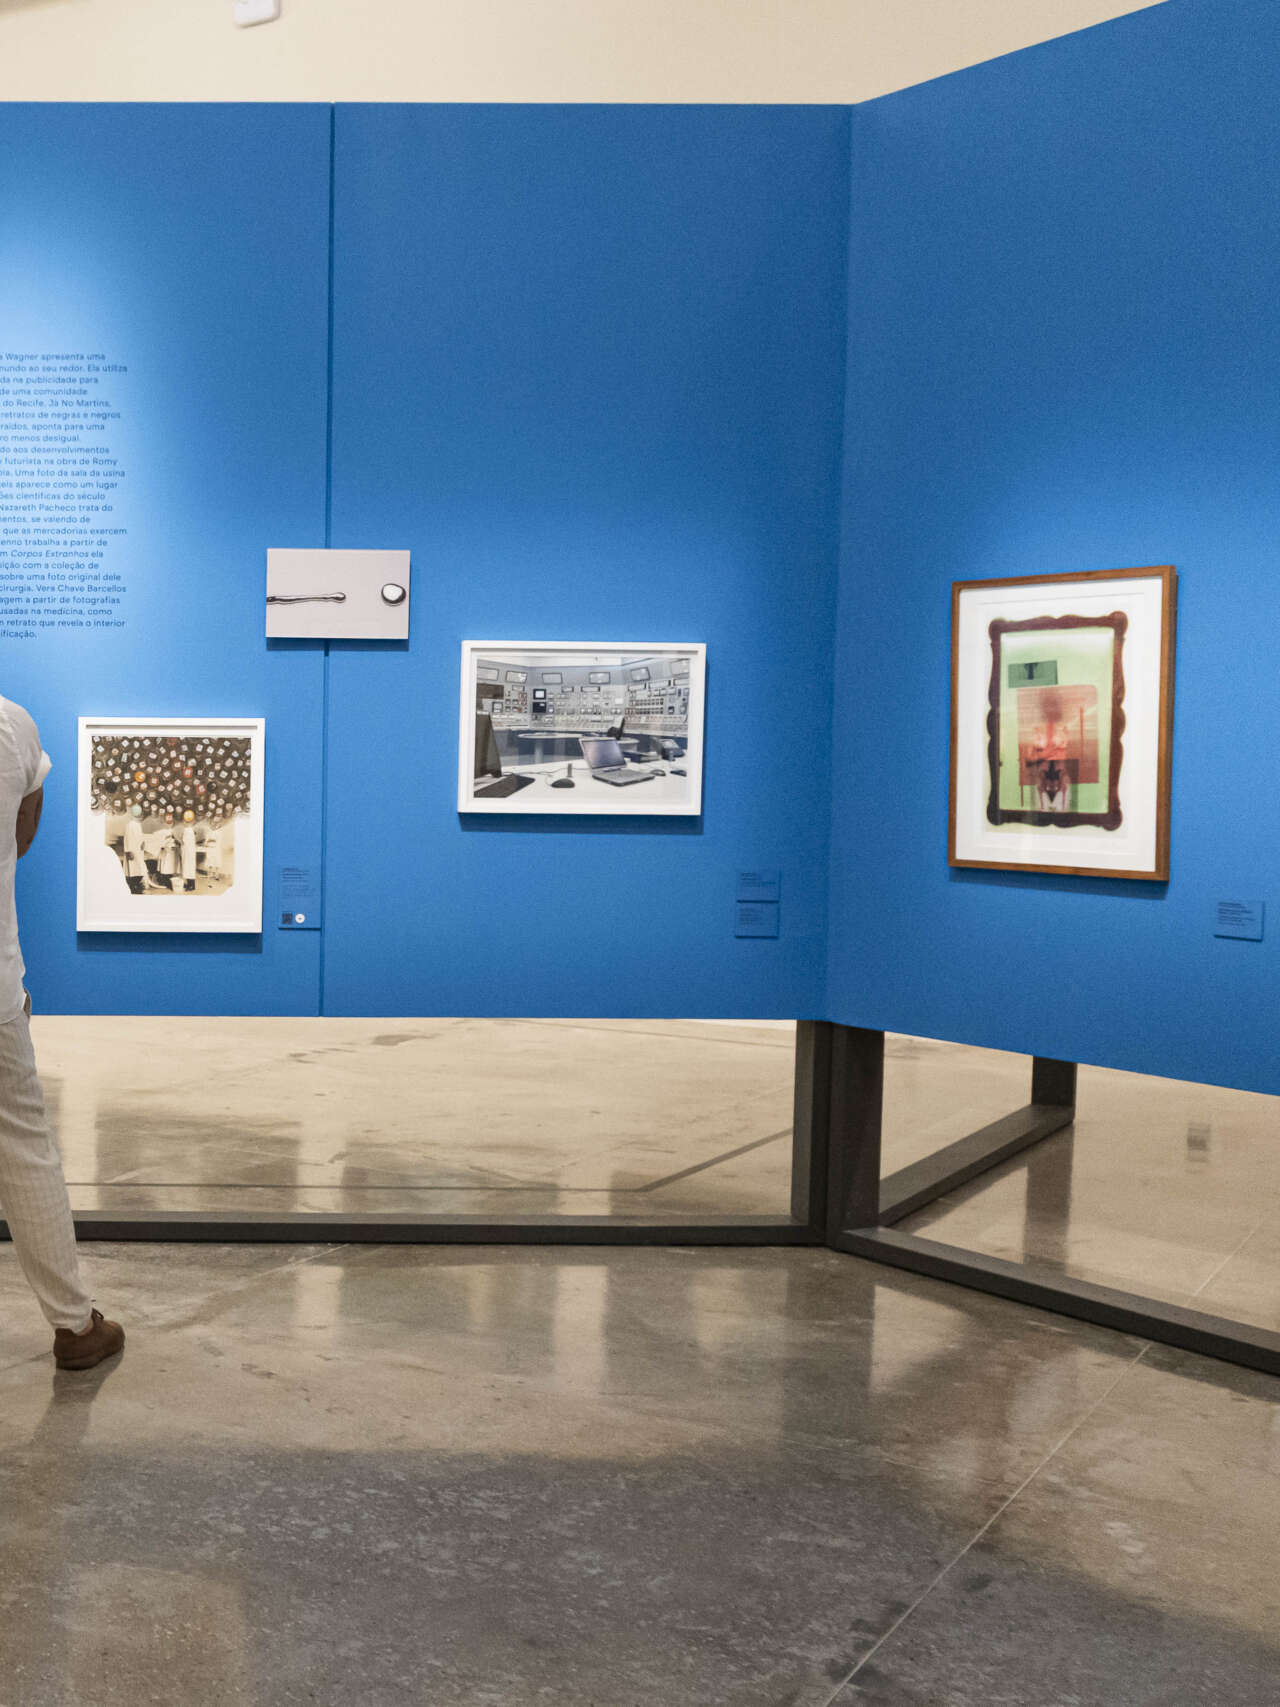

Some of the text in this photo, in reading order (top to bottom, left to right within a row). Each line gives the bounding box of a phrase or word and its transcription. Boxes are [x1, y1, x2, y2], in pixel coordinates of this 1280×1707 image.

[5, 351, 37, 362] Wagner
[41, 352, 84, 362] apresenta
[87, 363, 99, 372] Ela
[102, 363, 127, 372] utiliza
[25, 375, 76, 385] publicidade
[79, 377, 98, 385] para
[33, 386, 87, 395] comunidade
[2, 398, 13, 407] do
[61, 398, 73, 407] No
[76, 398, 110, 408] Martins,
[0, 410, 35, 418] retratos
[37, 410, 48, 418] de
[50, 412, 80, 420] negras
[90, 412, 120, 420] negros
[31, 421, 61, 432] aponta
[64, 423, 83, 432] para
[30, 445, 109, 453] desenvolvimentos
[4, 456, 41, 465] futurista
[56, 456, 76, 465] obra
[79, 456, 89, 465] de
[92, 456, 117, 467] Romy
[14, 468, 34, 476] Uma
[37, 468, 55, 476] foto
[57, 468, 67, 476] da
[70, 468, 86, 476] sala
[89, 468, 100, 477] da
[102, 468, 125, 477] usina
[15, 481, 50, 489] aparece
[63, 491, 74, 500] do
[38, 502, 75, 511] Pacheco
[78, 503, 99, 511] trata
[101, 503, 112, 511] do
[43, 514, 77, 523] valendo
[79, 514, 90, 523] de
[2, 527, 18, 536] que
[33, 526, 87, 534] mercadorias
[24, 537, 59, 546] trabalha
[70, 537, 93, 547] partir
[96, 537, 107, 546] de
[10, 548, 42, 559] Corpos
[90, 549, 103, 558] ela
[51, 560, 84, 570] coleção
[87, 560, 99, 569] de
[0, 572, 24, 580] sobre
[47, 572, 65, 580] foto
[68, 572, 100, 582] original
[102, 572, 120, 581] dele
[36, 583, 55, 592] Vera
[87, 584, 126, 592] Barcellos
[32, 595, 55, 605] partir
[59, 595, 70, 604] de
[72, 595, 120, 605] fotografias
[43, 606, 84, 616] medicina,
[6, 618, 36, 626] retrato
[39, 620, 55, 628] que
[57, 618, 83, 626] revela
[93, 618, 124, 627] interior
